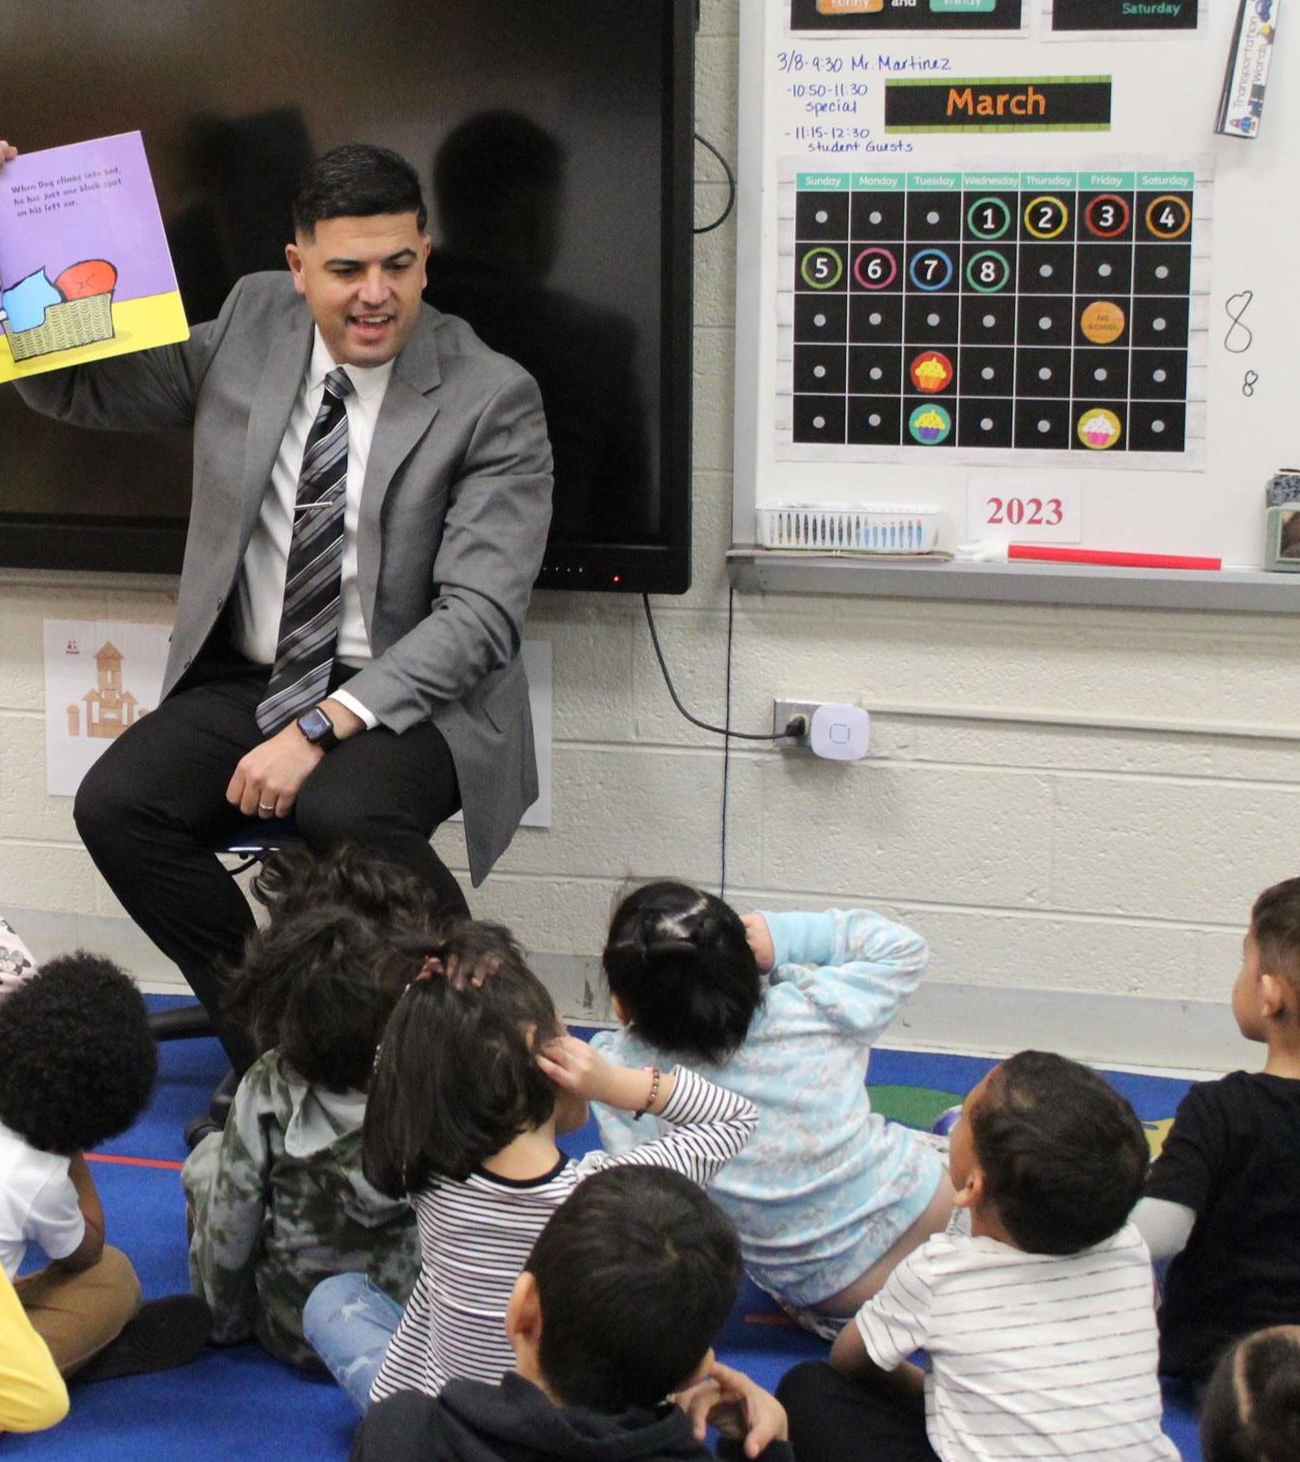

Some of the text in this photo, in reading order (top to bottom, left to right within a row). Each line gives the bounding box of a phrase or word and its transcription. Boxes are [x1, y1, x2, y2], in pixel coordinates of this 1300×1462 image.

[1122, 3, 1181, 16] Saturday
[851, 55, 874, 71] Mr.
[878, 55, 952, 71] Martinez
[1233, 16, 1257, 108] Transportation
[1254, 45, 1268, 82] Words
[805, 101, 857, 117] special
[946, 86, 1046, 116] March
[808, 141, 913, 153] student Guests
[11, 183, 36, 194] When
[38, 179, 54, 190] Dog
[84, 170, 102, 180] into
[805, 175, 1189, 188] Sunday Monday Tuesday Wednesday Thursday Friday Saturday
[44, 190, 60, 201] just
[29, 206, 42, 215] his
[44, 202, 60, 212] left
[983, 206, 1175, 229] 1 2 3 4
[815, 257, 995, 282] 5 6 7 8
[1224, 290, 1253, 353] 8
[1242, 370, 1258, 397] 8
[986, 497, 1064, 525] 2023
